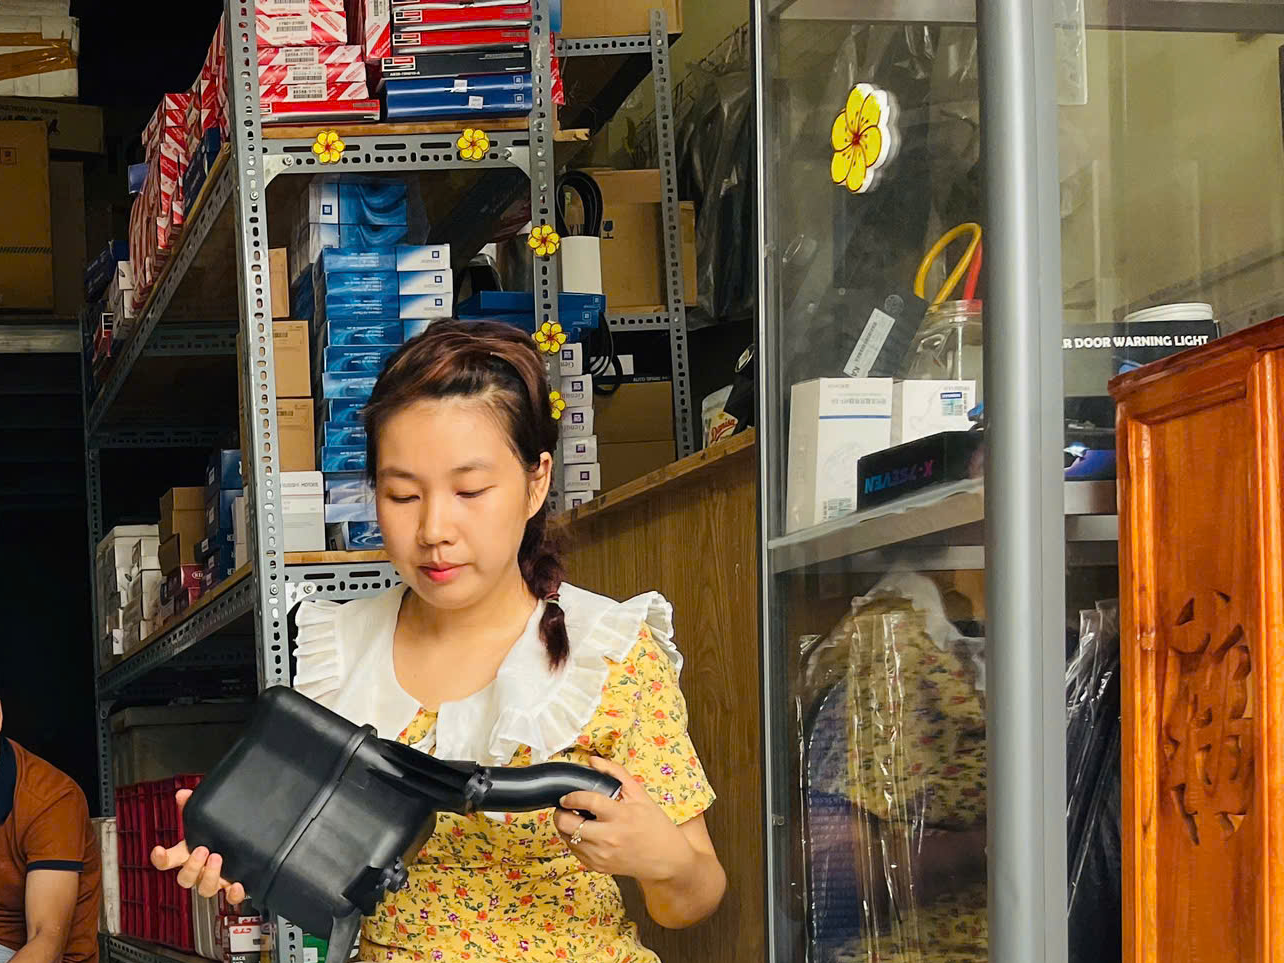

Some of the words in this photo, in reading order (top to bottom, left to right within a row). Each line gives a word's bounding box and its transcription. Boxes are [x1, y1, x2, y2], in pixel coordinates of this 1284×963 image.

[1075, 337, 1111, 349] DOOR
[1114, 336, 1172, 348] WARNING
[1174, 335, 1208, 346] LIGHT
